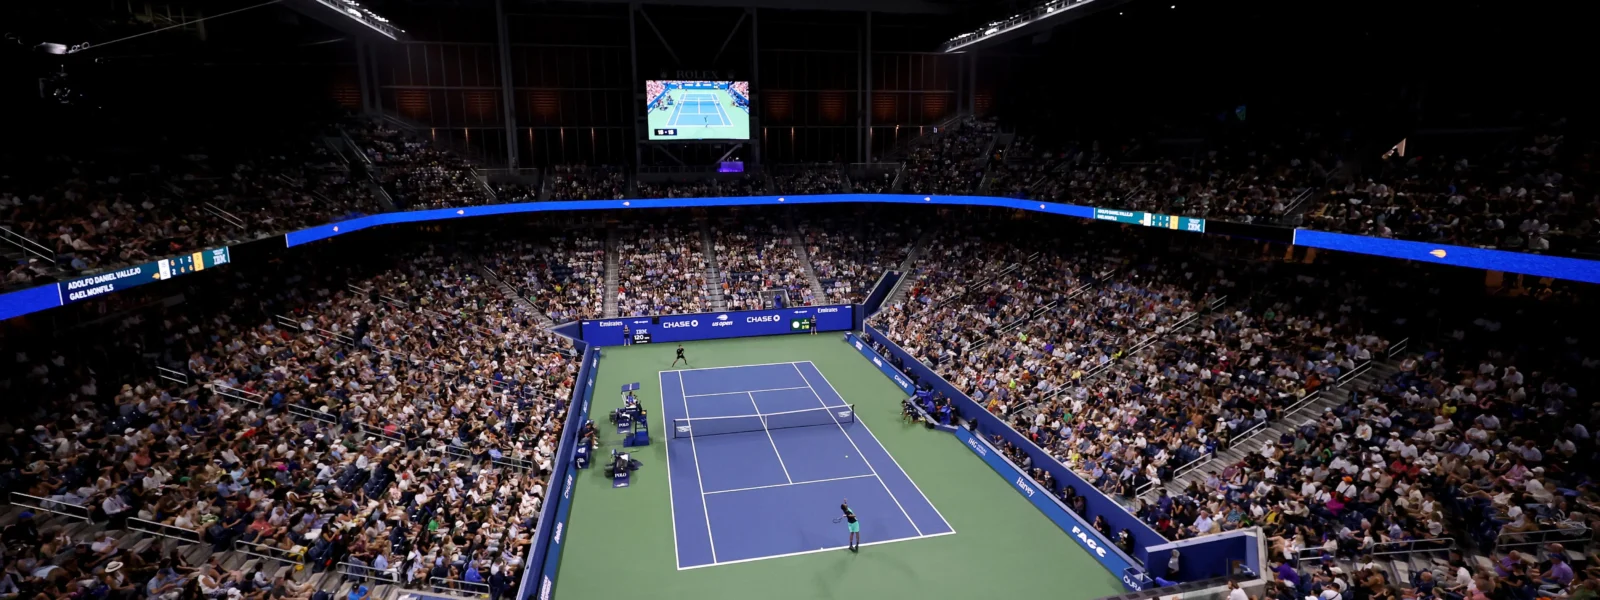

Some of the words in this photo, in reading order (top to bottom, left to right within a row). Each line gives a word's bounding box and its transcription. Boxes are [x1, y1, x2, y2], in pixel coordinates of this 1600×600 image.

[676, 70, 719, 79] ROLEX
[213, 254, 227, 265] IBM
[68, 278, 94, 290] ADOLFO
[94, 273, 116, 284] DANIEL
[116, 267, 141, 278] VALLEJO
[69, 291, 87, 300] GAEL
[87, 284, 114, 296] MONFILS
[1016, 476, 1035, 497] Harvey
[1072, 526, 1106, 557] FAGE
